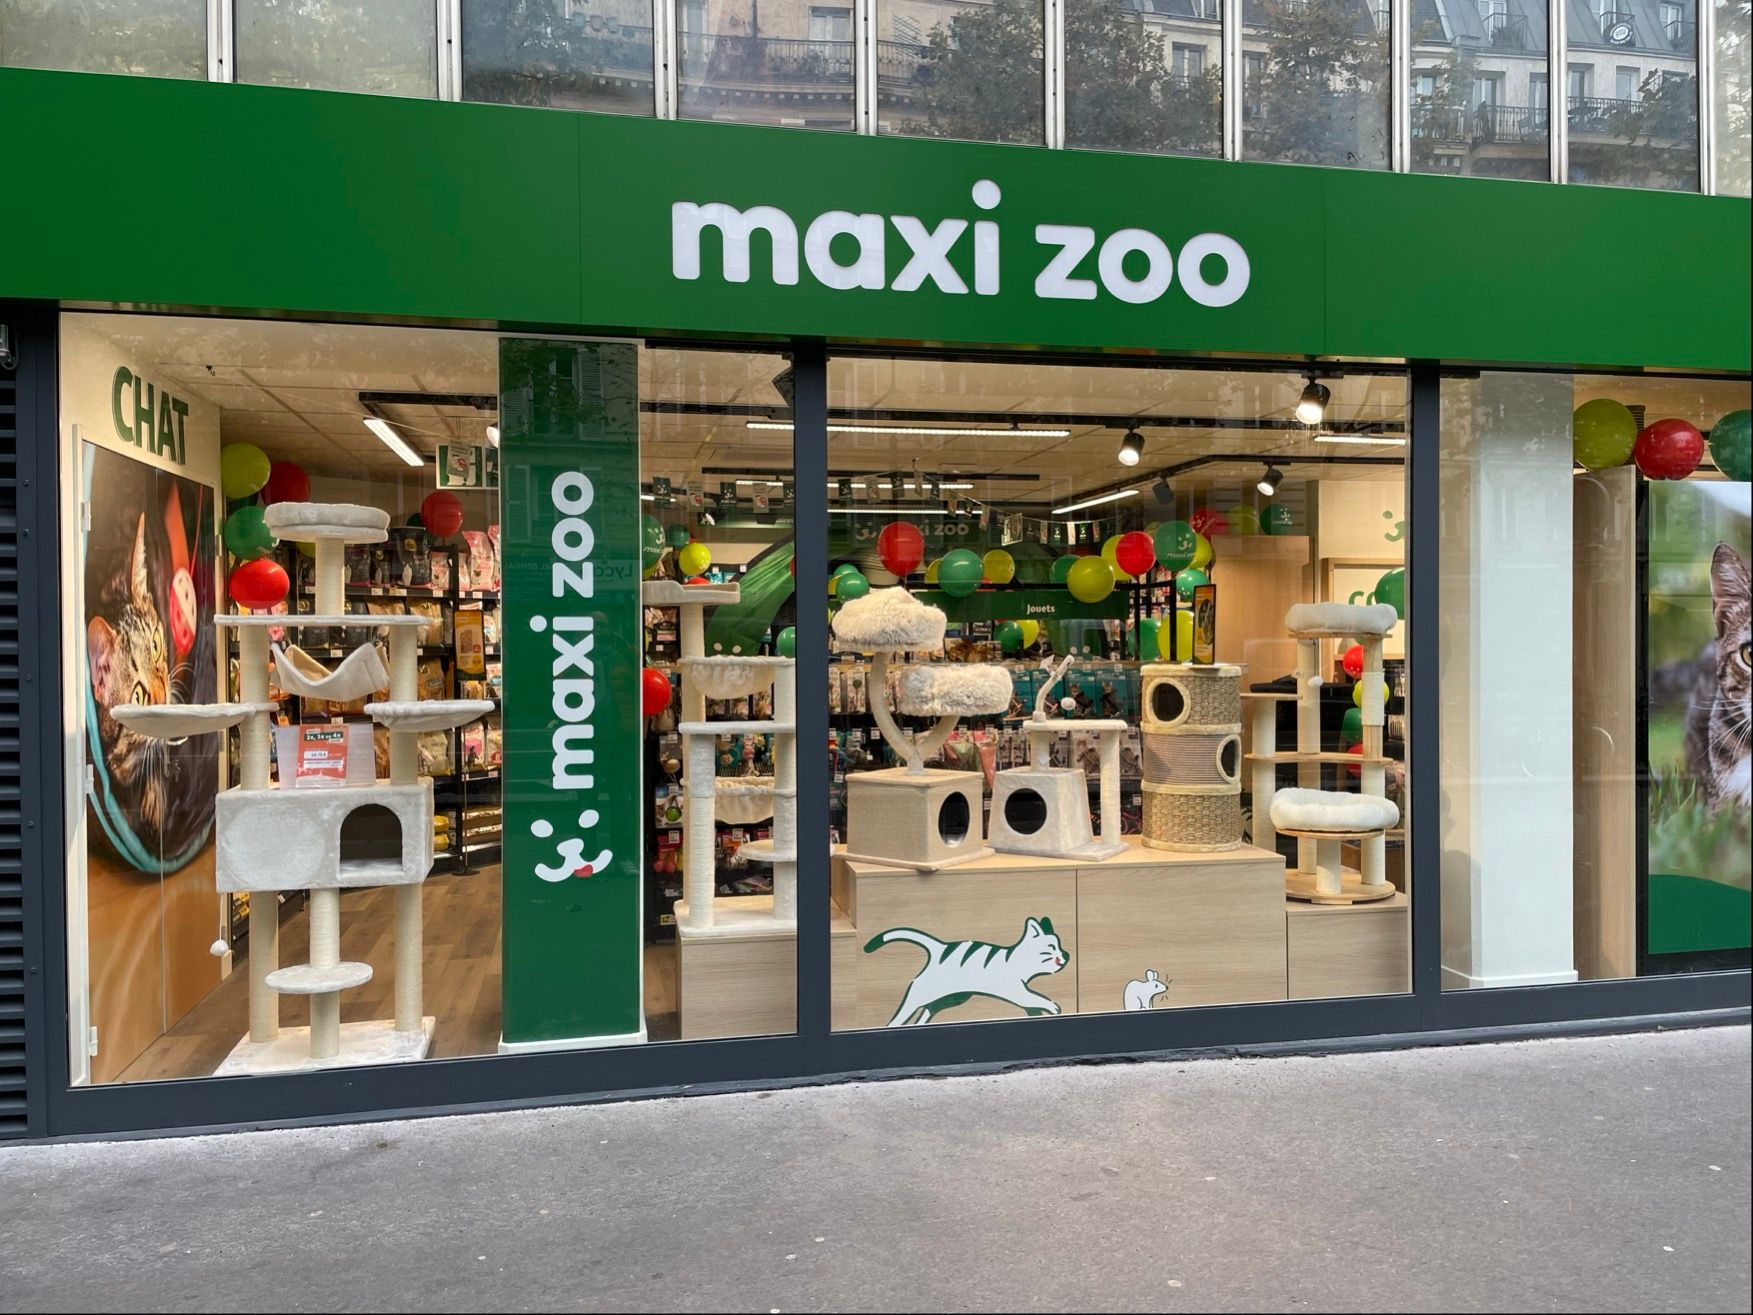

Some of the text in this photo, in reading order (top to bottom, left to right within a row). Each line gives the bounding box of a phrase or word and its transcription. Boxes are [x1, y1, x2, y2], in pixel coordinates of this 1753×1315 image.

[673, 181, 1249, 306] maxi zoo
[112, 365, 189, 465] CHAT
[934, 523, 969, 536] zoo
[530, 472, 594, 788] maxi zoo
[1026, 603, 1056, 616] Jouets
